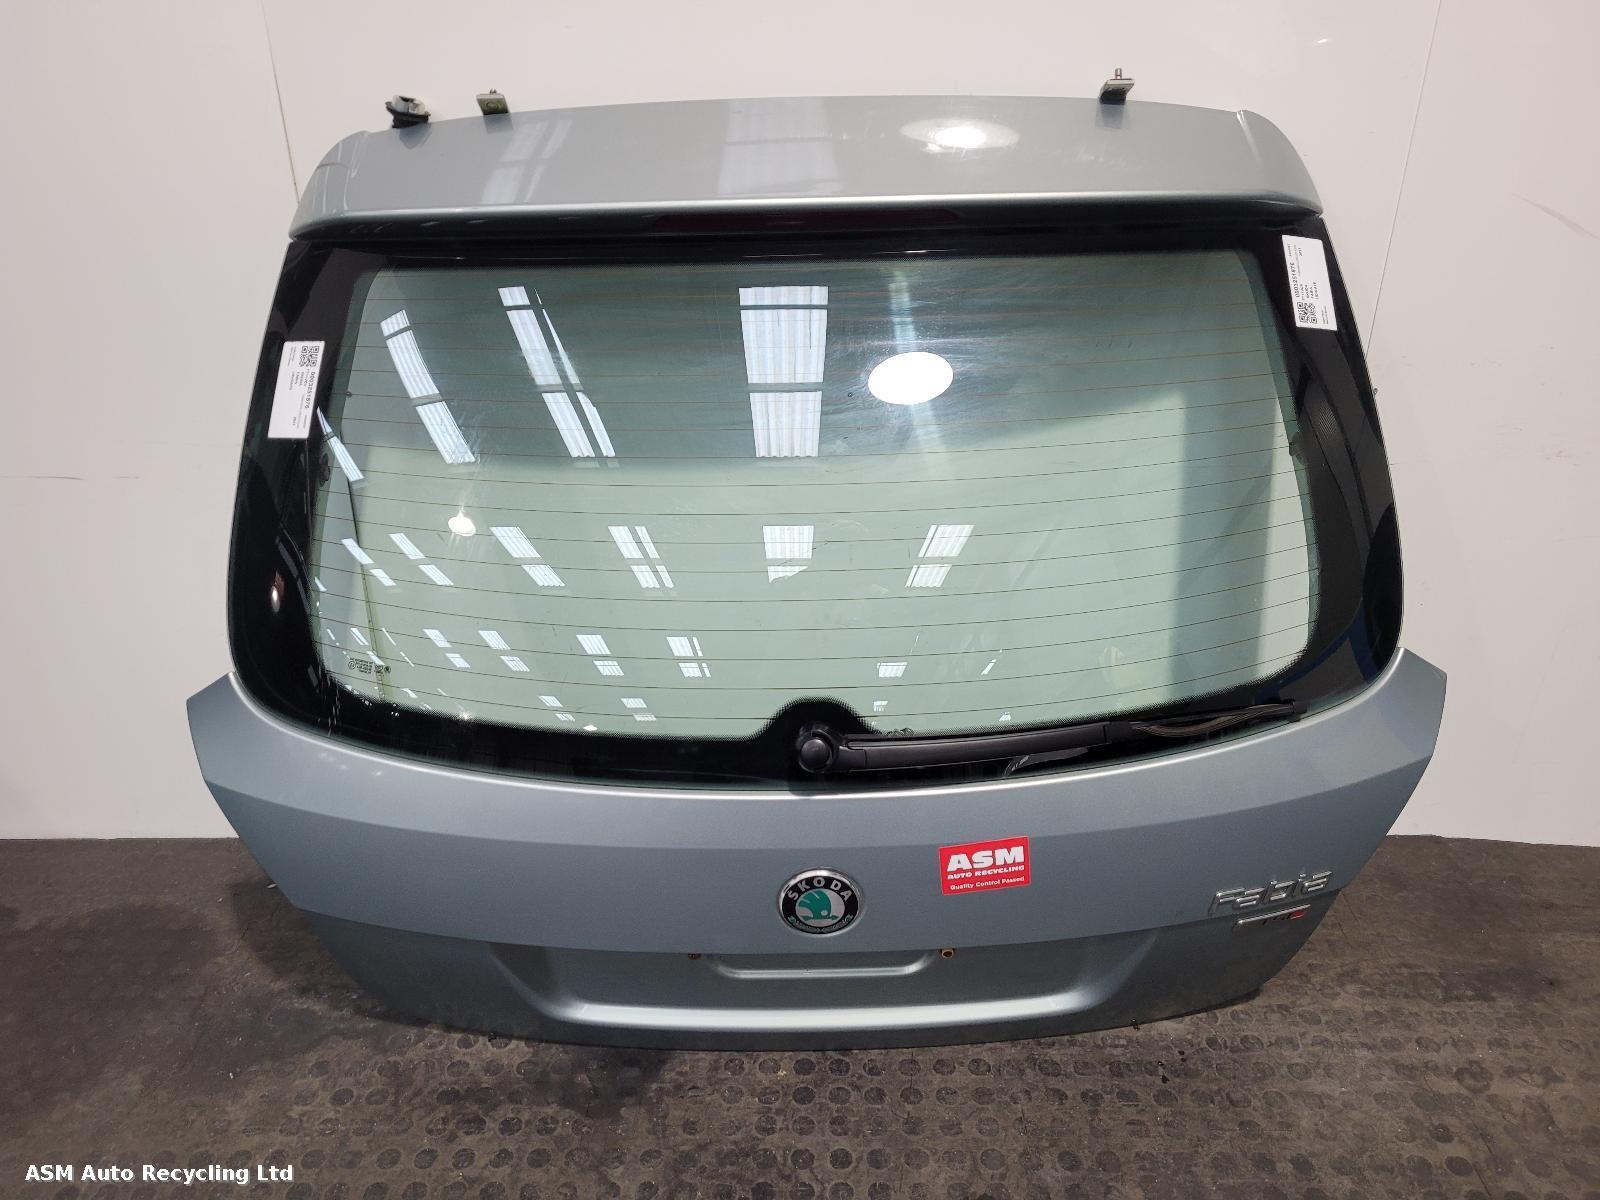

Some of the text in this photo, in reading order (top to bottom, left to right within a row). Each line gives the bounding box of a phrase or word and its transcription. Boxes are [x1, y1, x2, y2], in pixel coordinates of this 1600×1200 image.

[946, 845, 1025, 872] ASM
[947, 864, 1025, 880] AUTO RECYCLING
[950, 876, 1025, 891] Quality Control Passed
